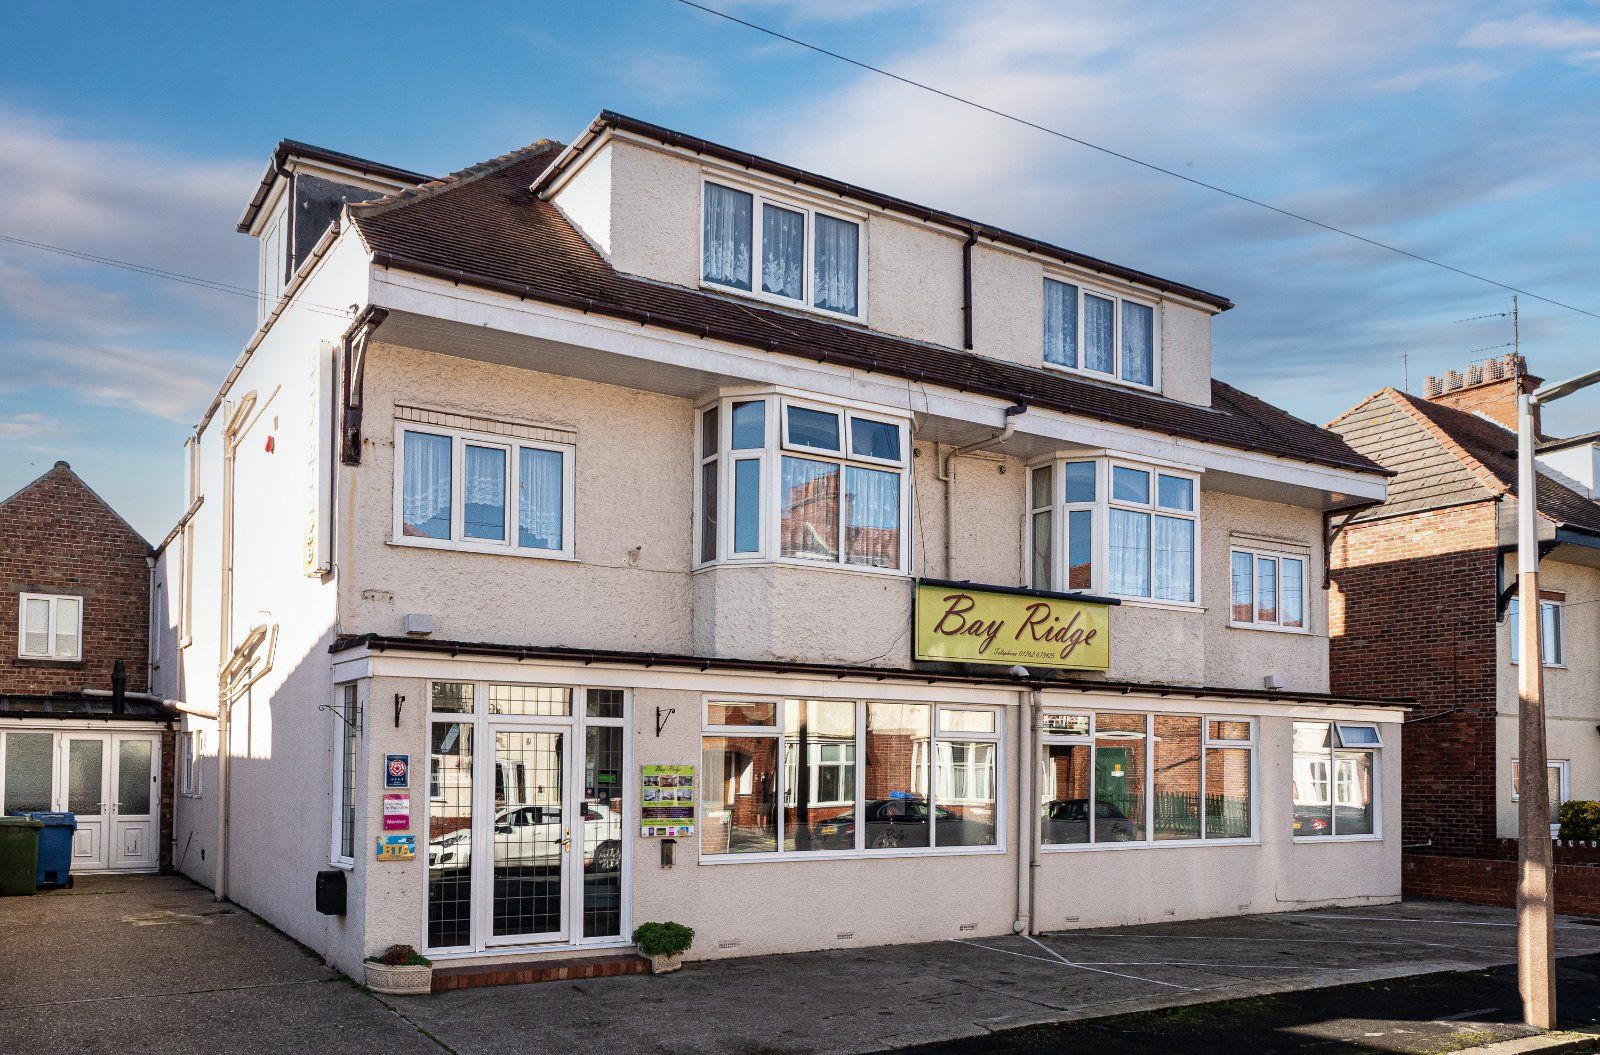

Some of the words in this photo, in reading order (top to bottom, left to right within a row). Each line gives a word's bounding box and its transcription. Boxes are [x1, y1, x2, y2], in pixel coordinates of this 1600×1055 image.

[934, 593, 1005, 655] Bay
[1015, 602, 1097, 660] Ridge
[994, 647, 1018, 657] Telephone
[883, 828, 910, 842] Ridge
